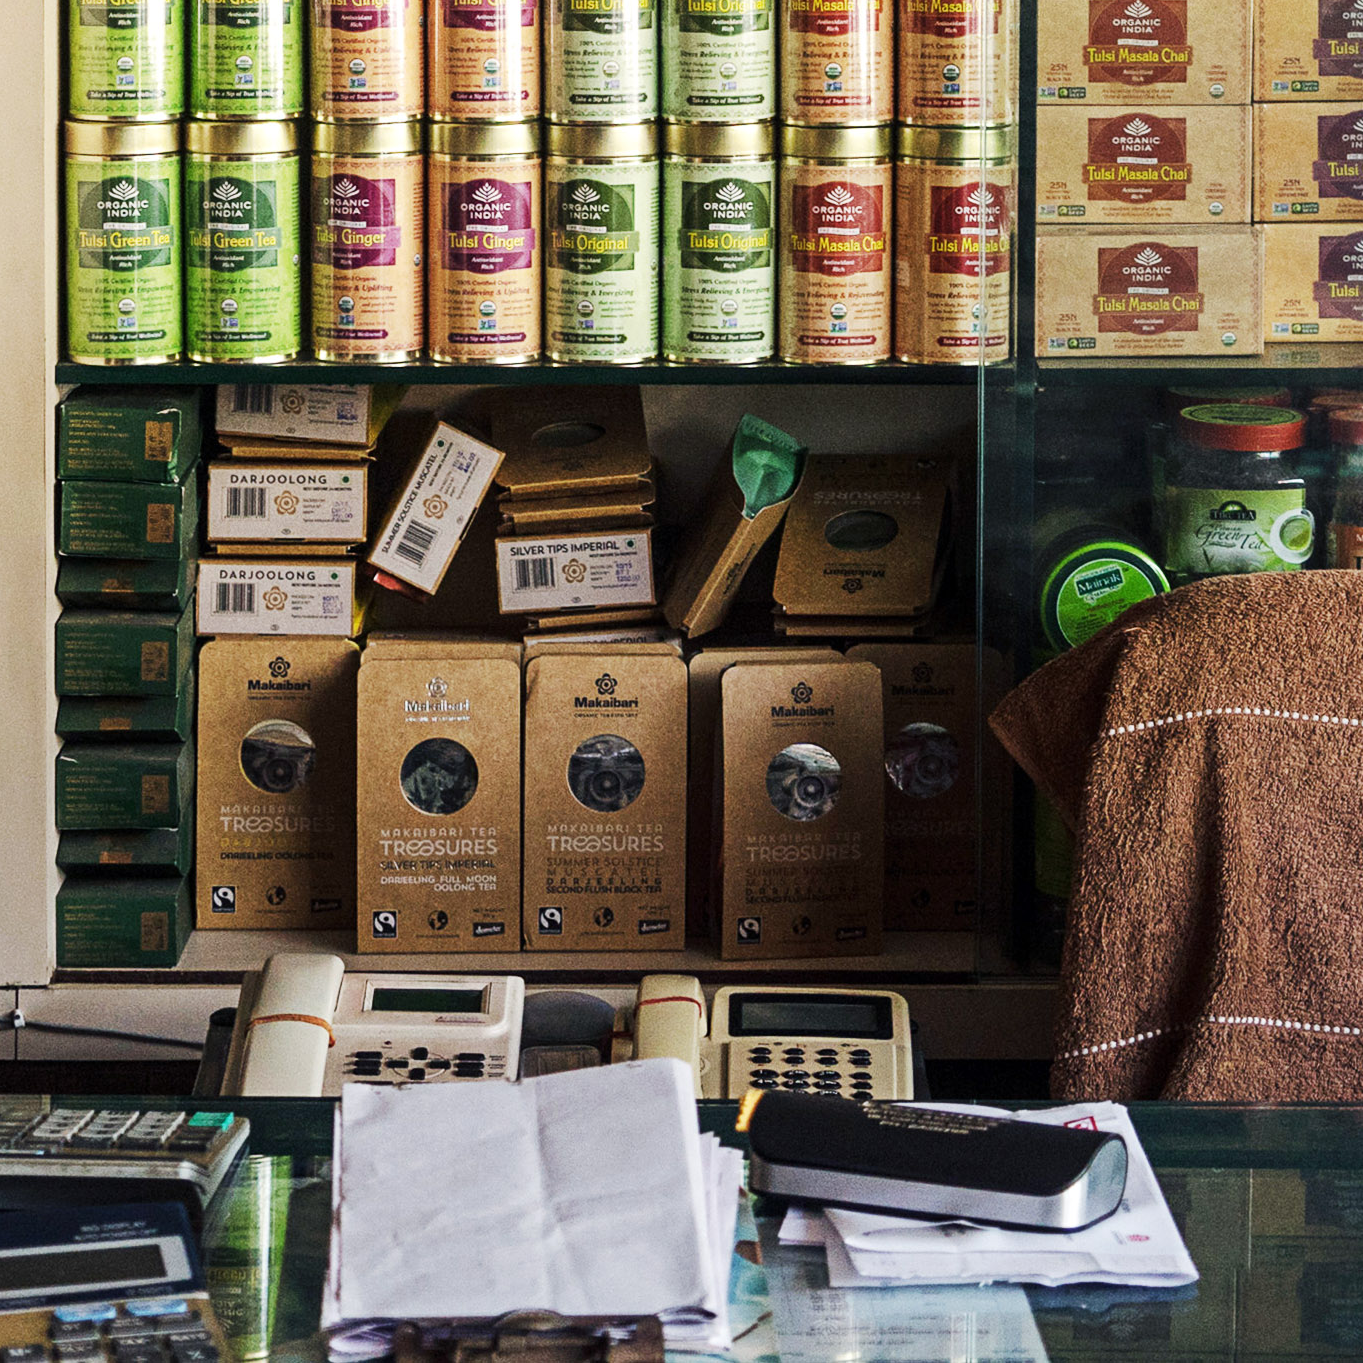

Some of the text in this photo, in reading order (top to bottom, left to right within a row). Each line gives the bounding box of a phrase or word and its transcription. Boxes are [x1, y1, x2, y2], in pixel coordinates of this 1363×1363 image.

[449, 234, 525, 249] Tulsi Ginger
[689, 233, 768, 250] Tulsi Original
[231, 475, 327, 484] DARJOOLONG
[383, 454, 437, 553] SUMMER SOLSTICE MUSCATEL
[511, 542, 619, 556] SILVER TIPS IMPERIAL
[220, 570, 315, 580] DARJOOLONG
[248, 679, 310, 691] Makaibari
[574, 697, 638, 707] Makaibari
